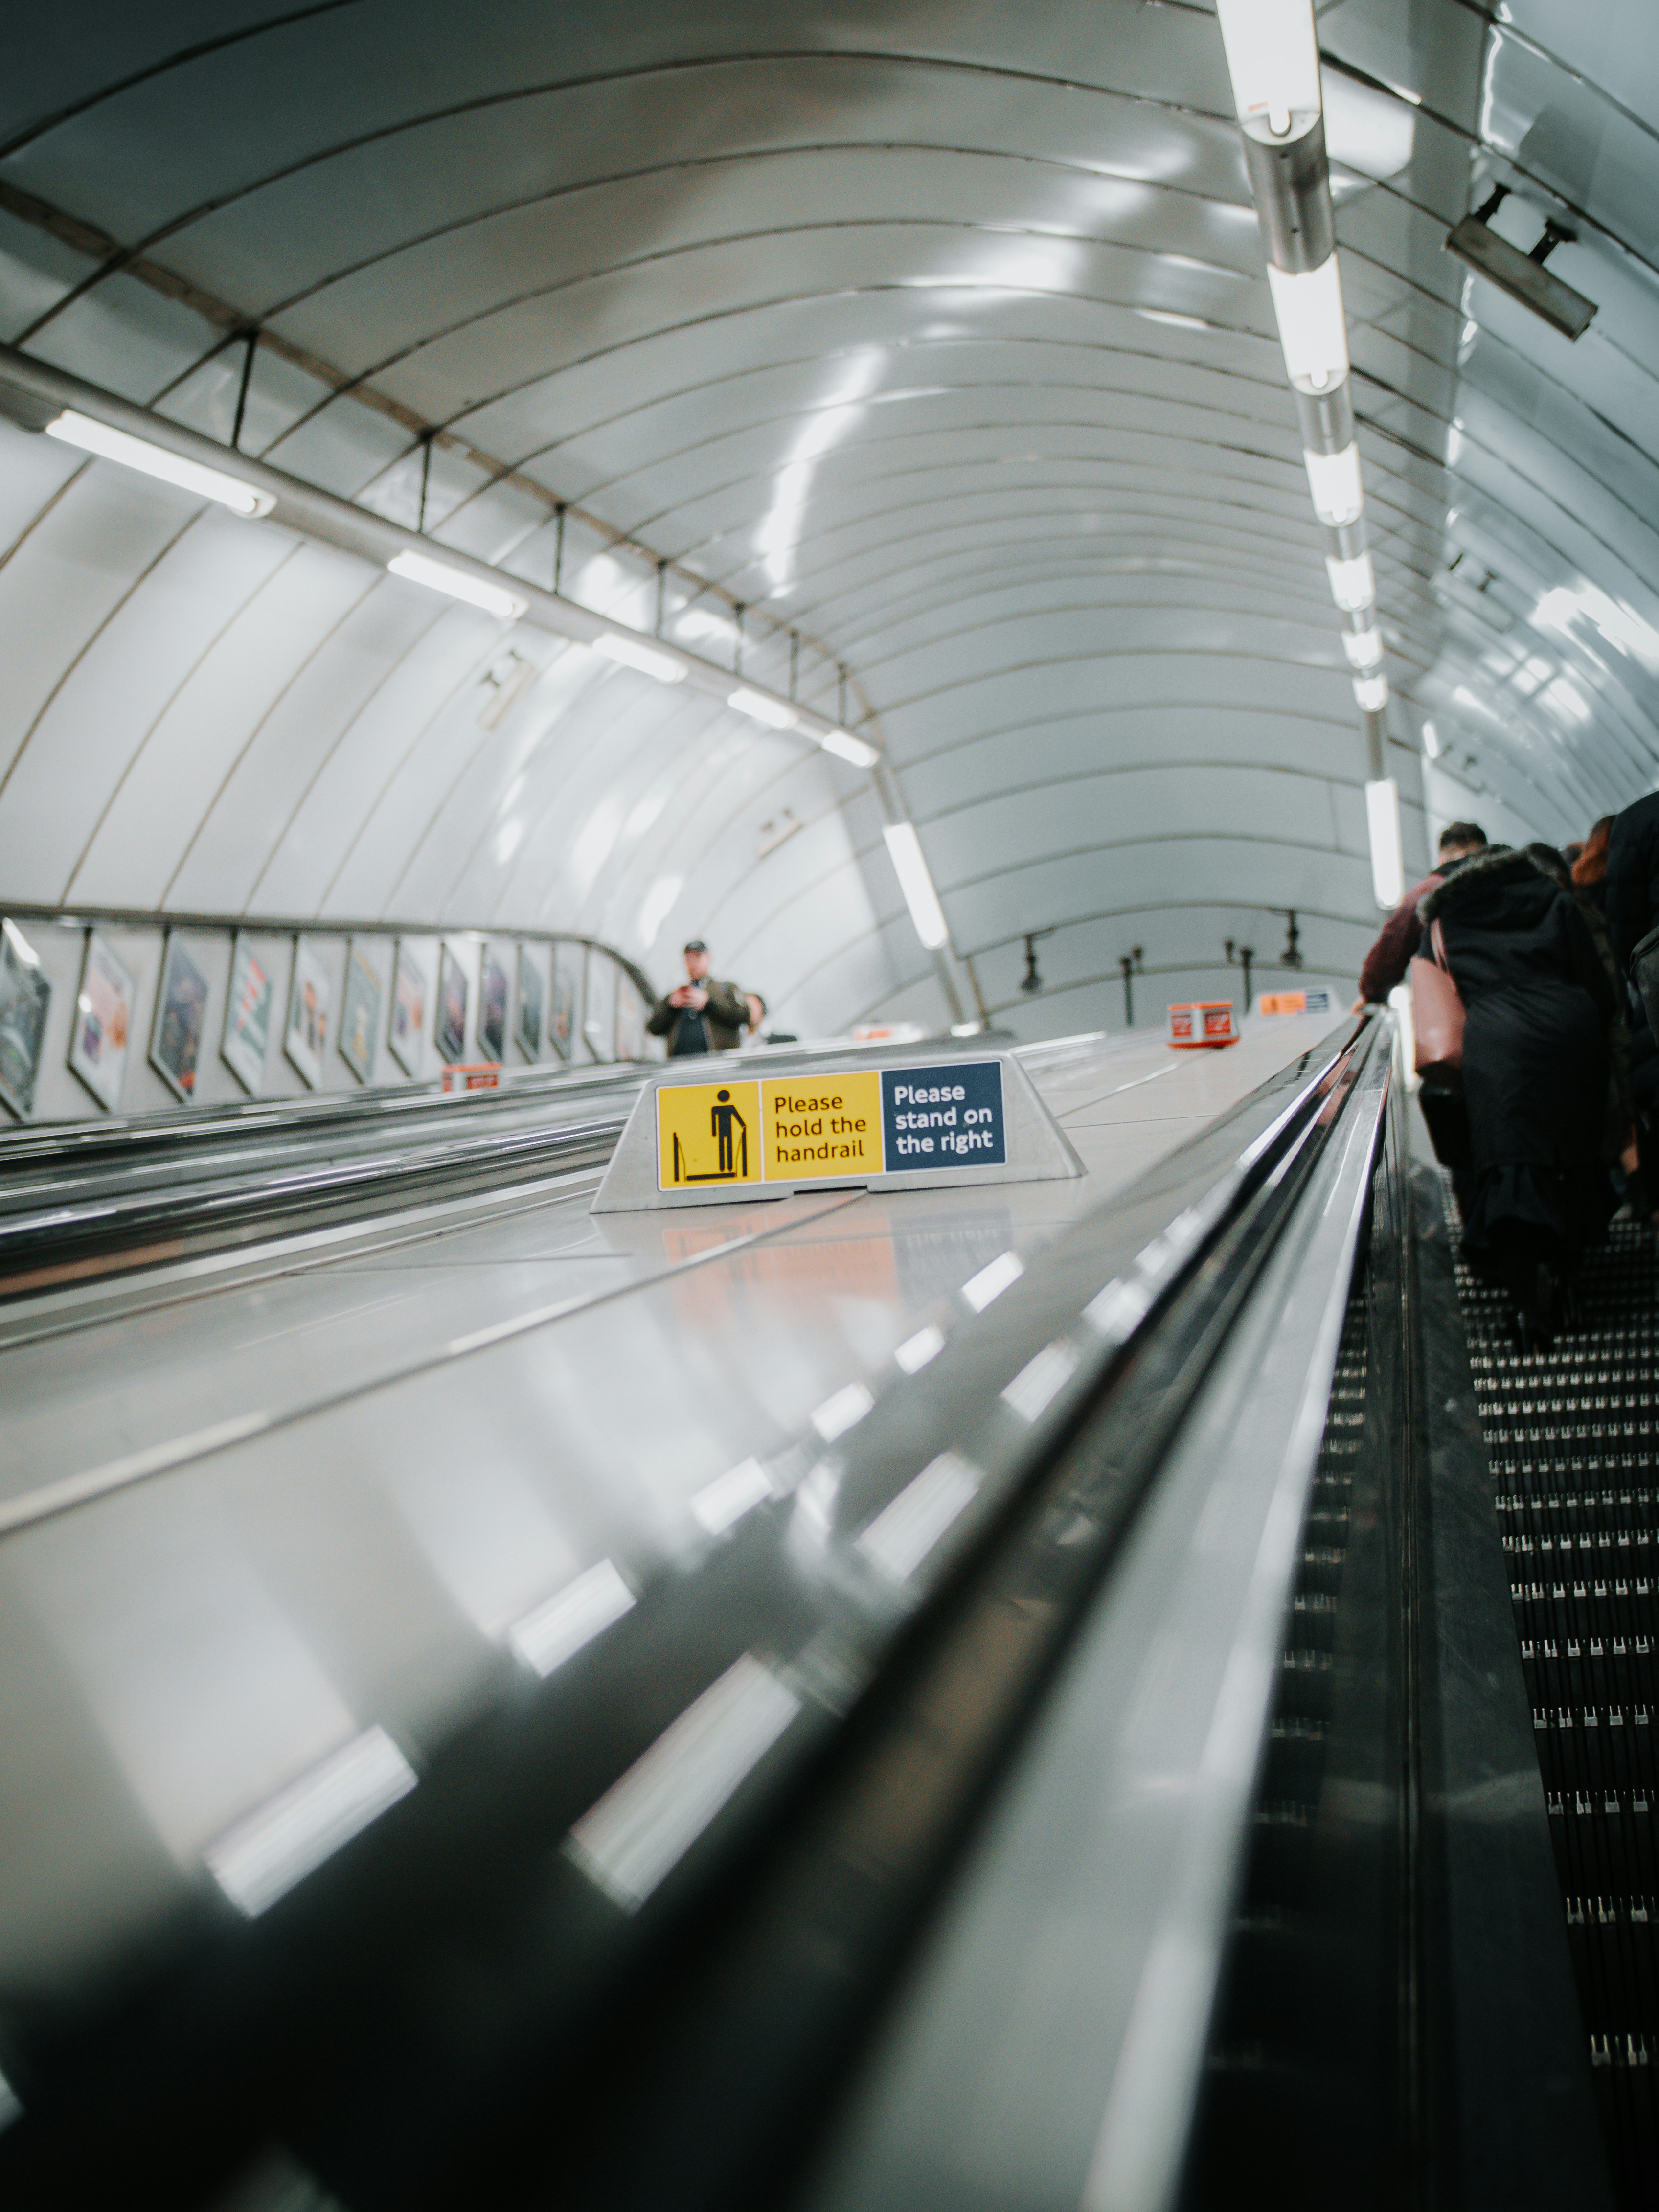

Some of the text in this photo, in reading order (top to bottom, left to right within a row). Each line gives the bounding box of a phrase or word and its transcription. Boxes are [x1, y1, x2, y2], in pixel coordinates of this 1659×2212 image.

[775, 1096, 842, 1113] Please
[894, 1085, 965, 1105] Please
[776, 1117, 866, 1138] hold the
[895, 1106, 993, 1130] stand on
[777, 1140, 864, 1162] handrail
[896, 1129, 993, 1154] the right
